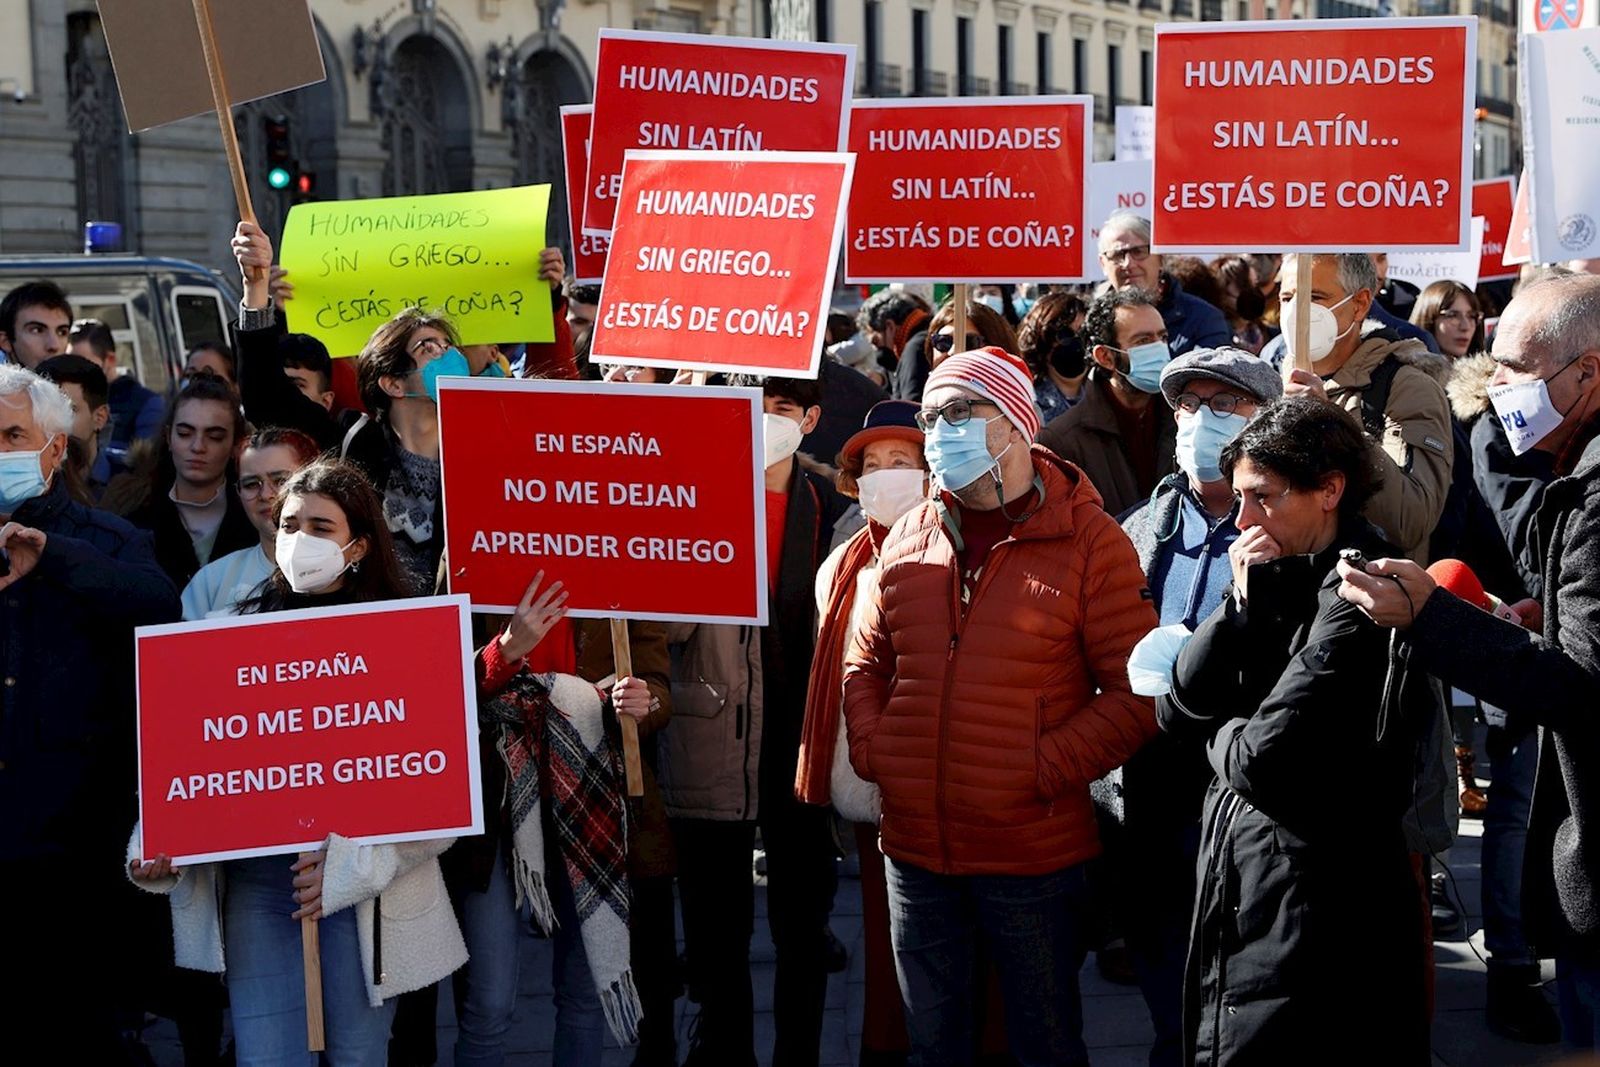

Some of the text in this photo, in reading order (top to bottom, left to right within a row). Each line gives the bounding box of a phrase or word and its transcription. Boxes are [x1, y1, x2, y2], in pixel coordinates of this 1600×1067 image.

[619, 65, 819, 103] HUMANIDADES
[1184, 55, 1435, 89] HUMANIDADES
[637, 121, 778, 151] SIN LATÍN
[868, 127, 1062, 152] HUMANIDADES
[1212, 112, 1399, 148] SIN LATÍN...
[891, 171, 1035, 200] SIN LATÍN...
[1117, 192, 1146, 208] NO
[1162, 174, 1450, 213] ¿ESTÁS DE COÑA?
[310, 205, 490, 236] HUMANIDADES
[636, 190, 816, 220] HUMANIDADES
[853, 221, 1075, 251] ¿ESTÁS DE COÑA?
[635, 246, 675, 272] SIN
[679, 247, 792, 278] GRIEGO...
[445, 290, 524, 317] COÑA?
[603, 297, 810, 337] ¿ESTÁS DE COÑA?
[535, 432, 661, 456] EN ESPAÑA
[503, 478, 696, 508] NO ME DEJAN
[471, 531, 734, 564] APRENDER GRIEGO
[237, 652, 368, 686] EN ESPAÑA
[203, 699, 406, 742] NO ME DEJAN
[166, 750, 446, 801] APRENDER GRIEGO
